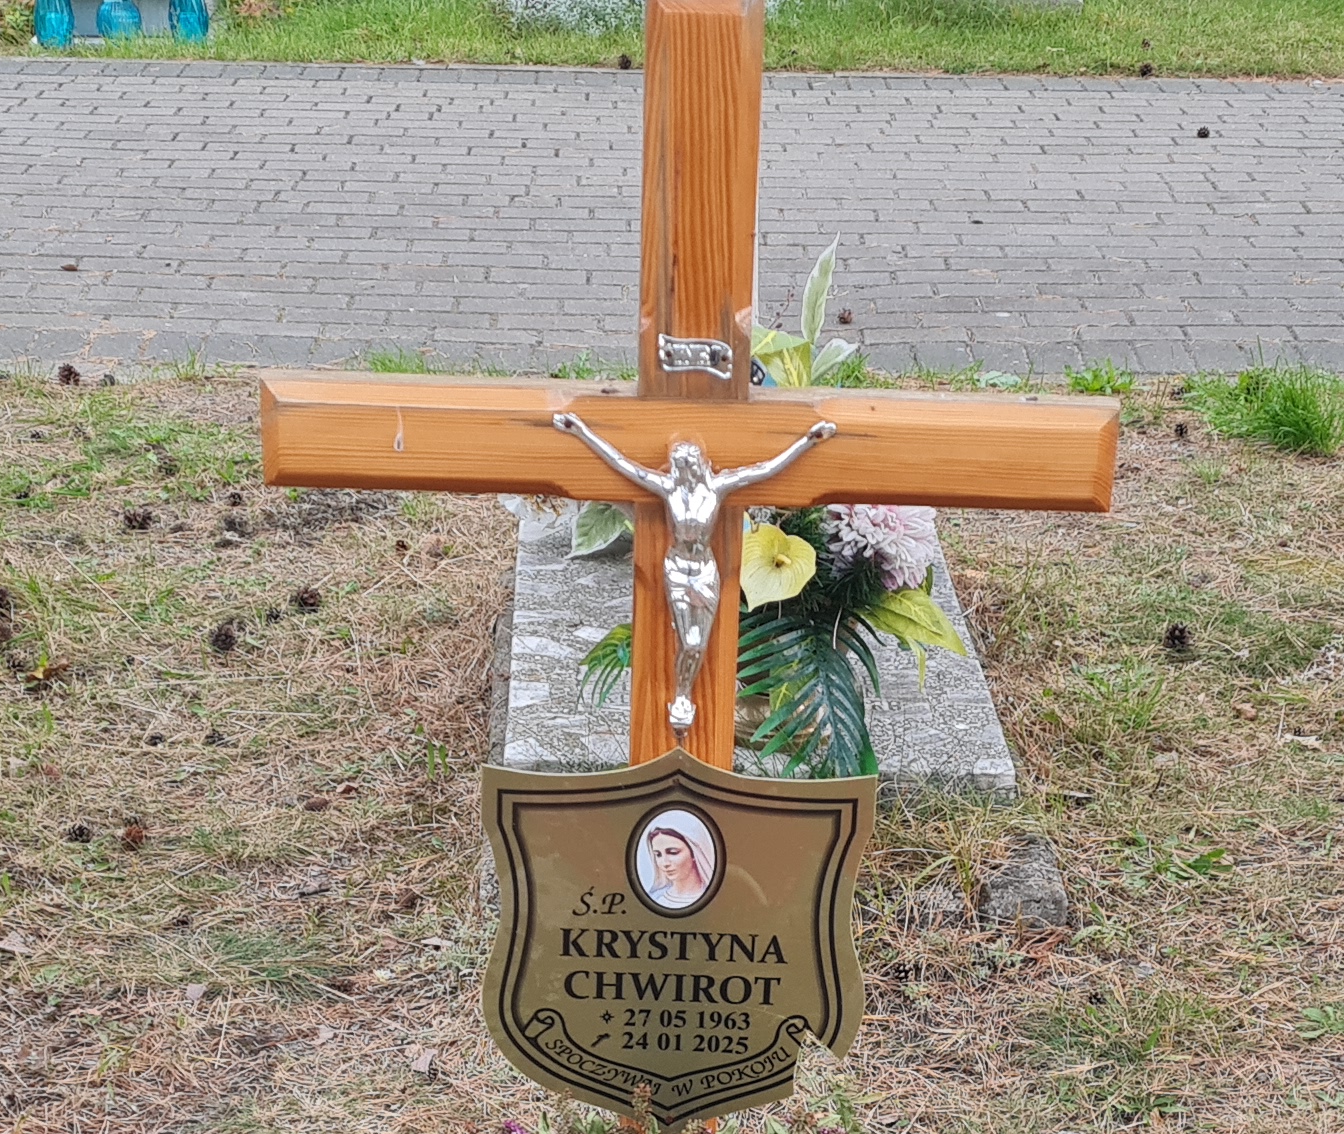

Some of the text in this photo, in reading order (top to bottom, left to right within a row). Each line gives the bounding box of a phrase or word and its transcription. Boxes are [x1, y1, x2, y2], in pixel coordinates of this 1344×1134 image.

[572, 886, 627, 917] Ś.P.
[559, 928, 788, 965] KRYSTYNA
[563, 970, 782, 1006] CHWIROT
[623, 1008, 751, 1030] 27 05 1963
[621, 1032, 749, 1055] 24 01 2025
[671, 1080, 694, 1098] W
[700, 1046, 792, 1091] POKOJU
